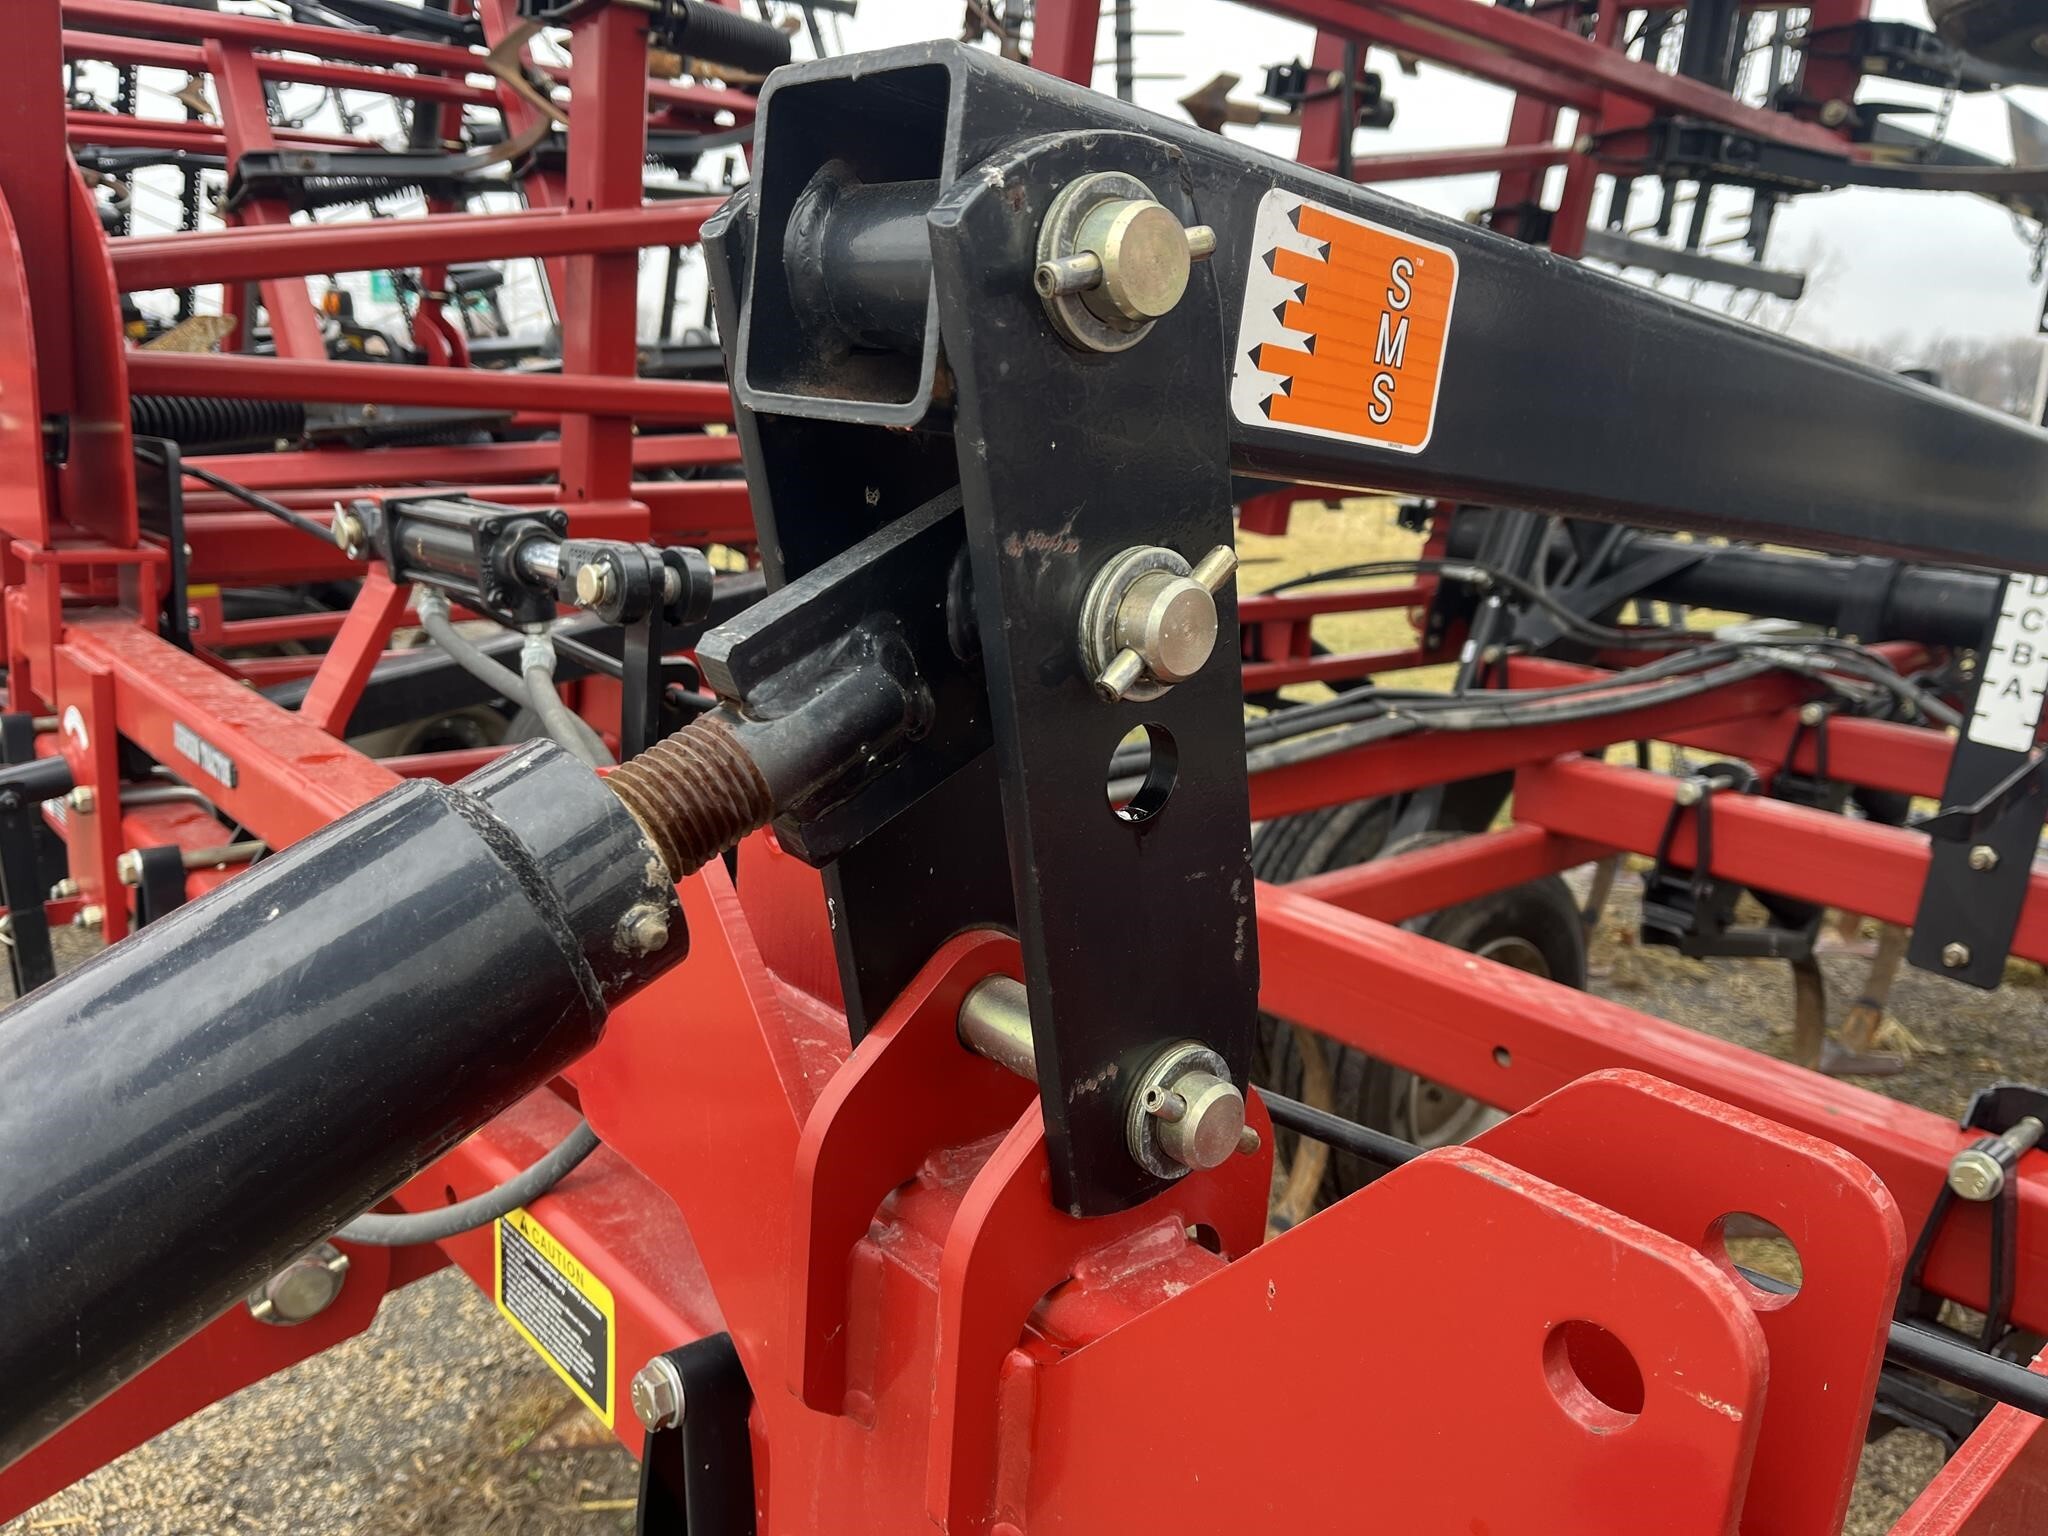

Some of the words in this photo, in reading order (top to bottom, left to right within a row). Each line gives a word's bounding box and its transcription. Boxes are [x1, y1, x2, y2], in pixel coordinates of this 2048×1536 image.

[1367, 255, 1414, 425] SMS
[2022, 608, 2044, 631] C
[2012, 643, 2033, 665] B
[2002, 677, 2022, 700] A
[531, 1226, 585, 1288] CAUTION
